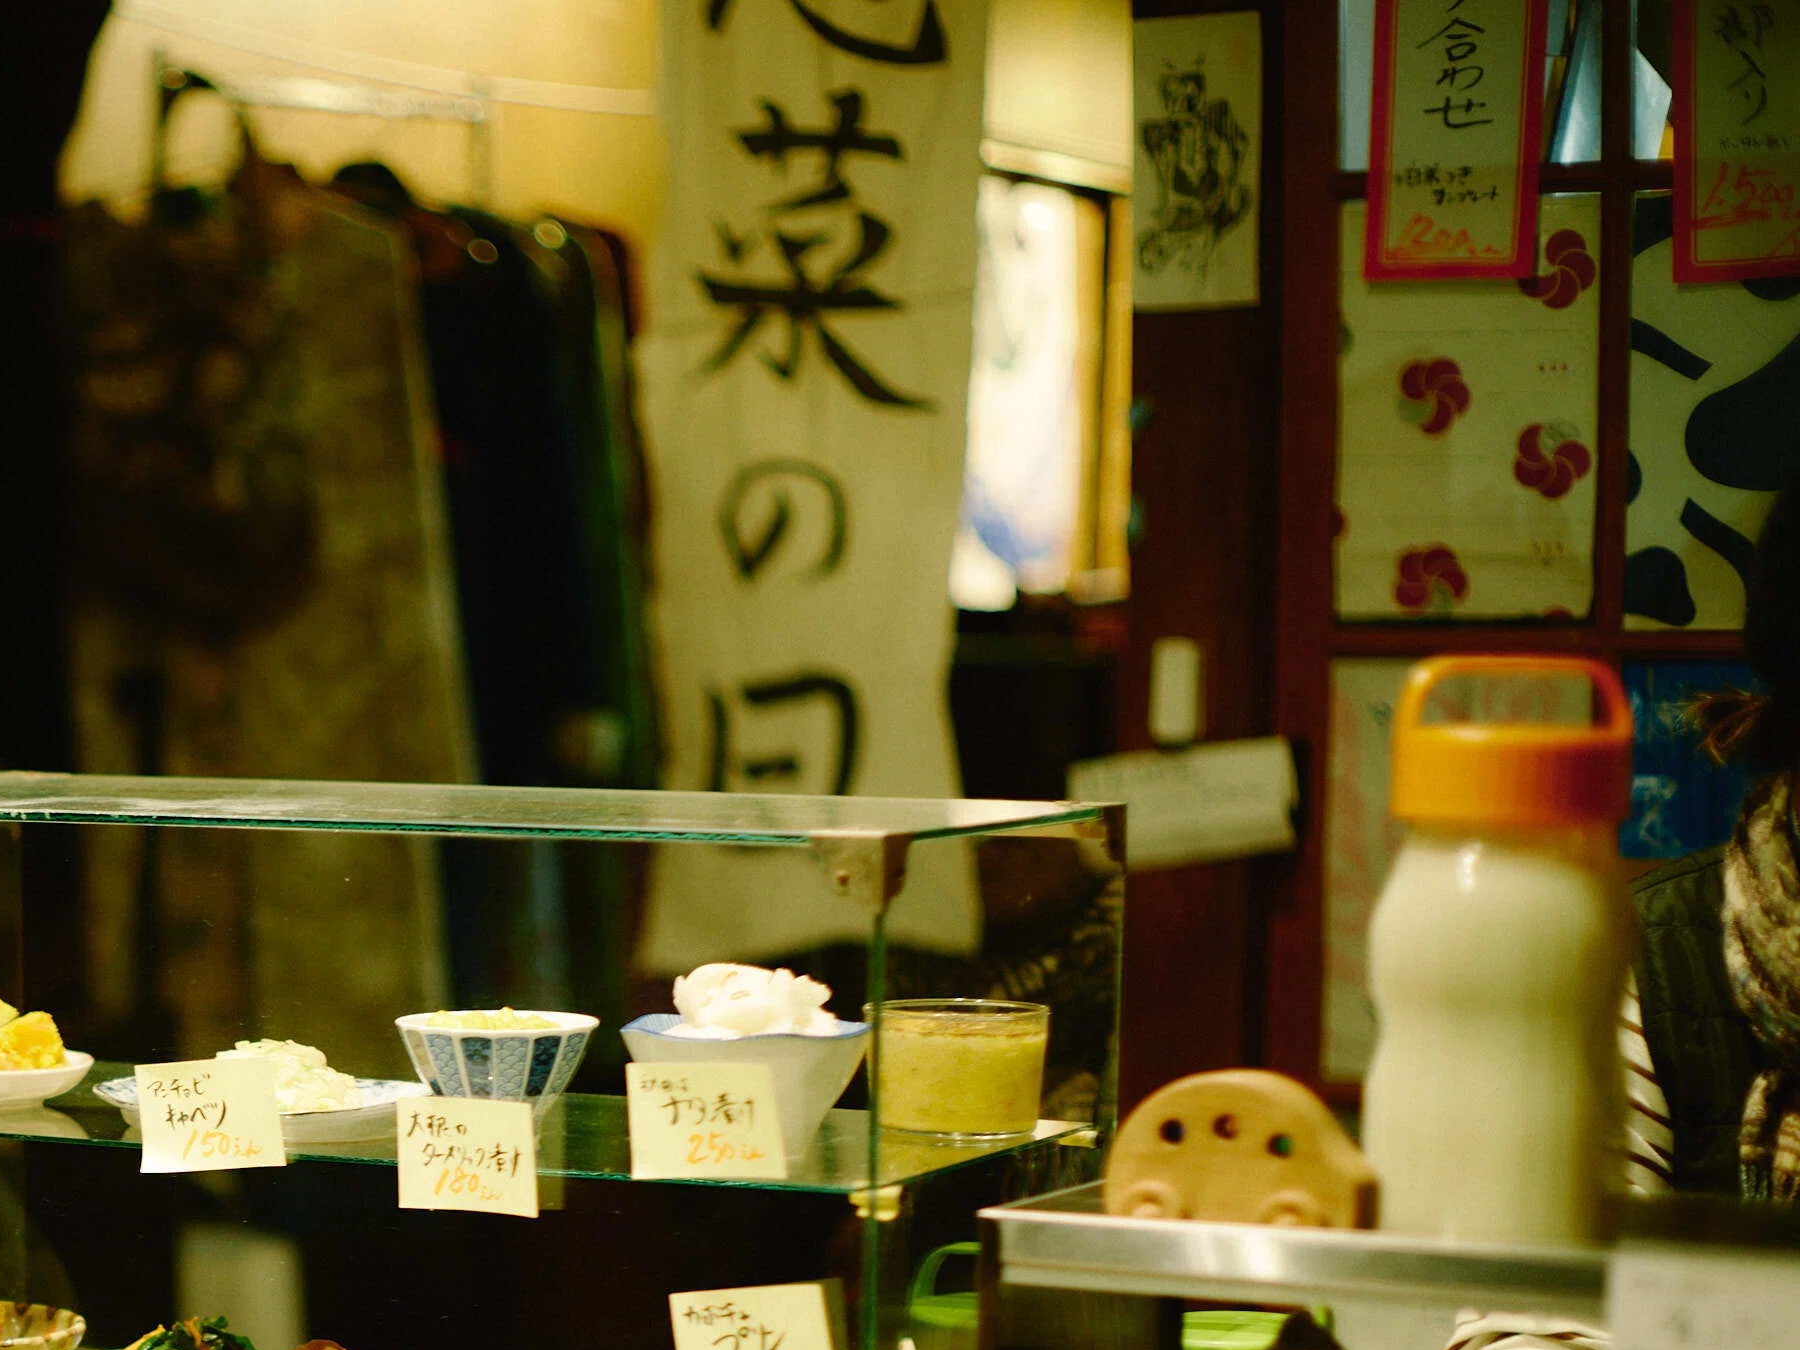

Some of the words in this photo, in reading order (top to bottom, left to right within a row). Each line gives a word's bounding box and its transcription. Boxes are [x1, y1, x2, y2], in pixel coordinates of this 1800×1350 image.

[1414, 0, 1494, 129] 合わせ
[690, 0, 952, 800] 菜の日
[146, 1073, 211, 1098] アンチョビ
[165, 1100, 227, 1133] キャベツ
[182, 1128, 264, 1161] 150えん
